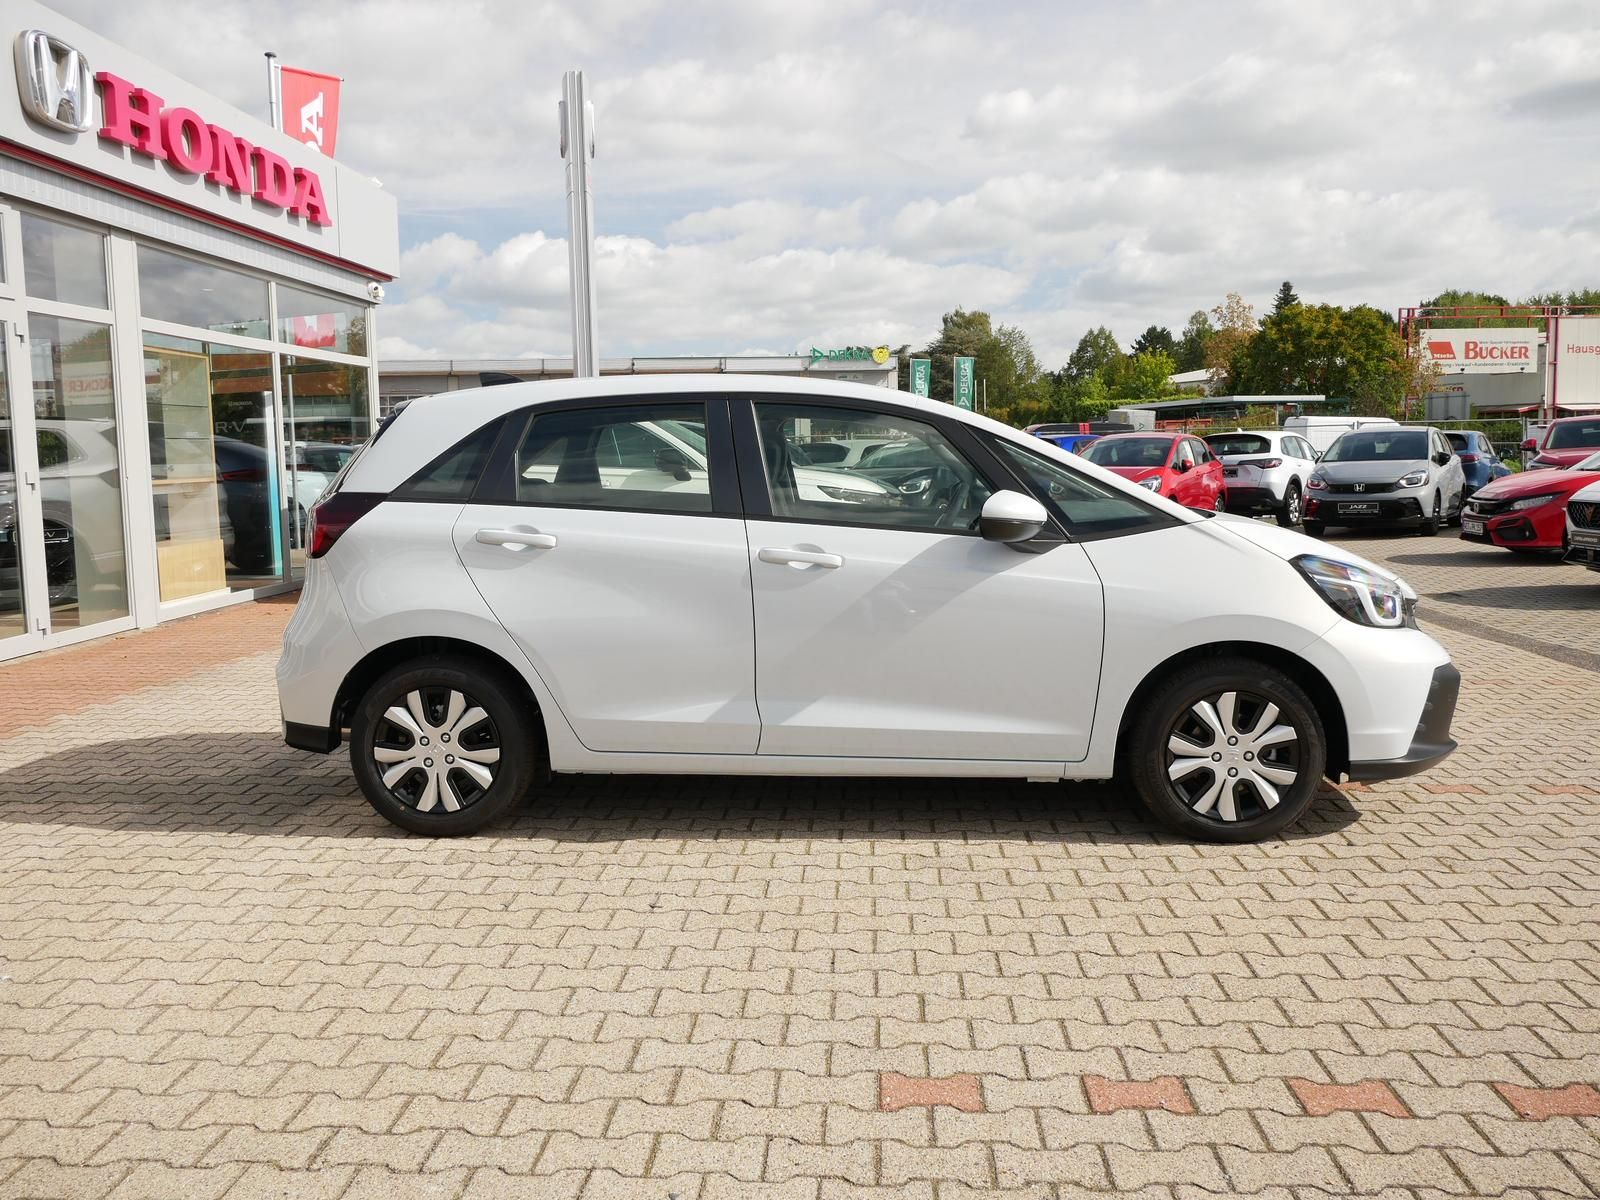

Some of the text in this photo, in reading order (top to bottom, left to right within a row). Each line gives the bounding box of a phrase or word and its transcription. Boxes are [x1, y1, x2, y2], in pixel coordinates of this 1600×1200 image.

[95, 71, 333, 227] HONDA
[829, 349, 871, 361] DEKRA
[915, 365, 927, 396] DEKRA
[960, 363, 969, 394] DEKRA
